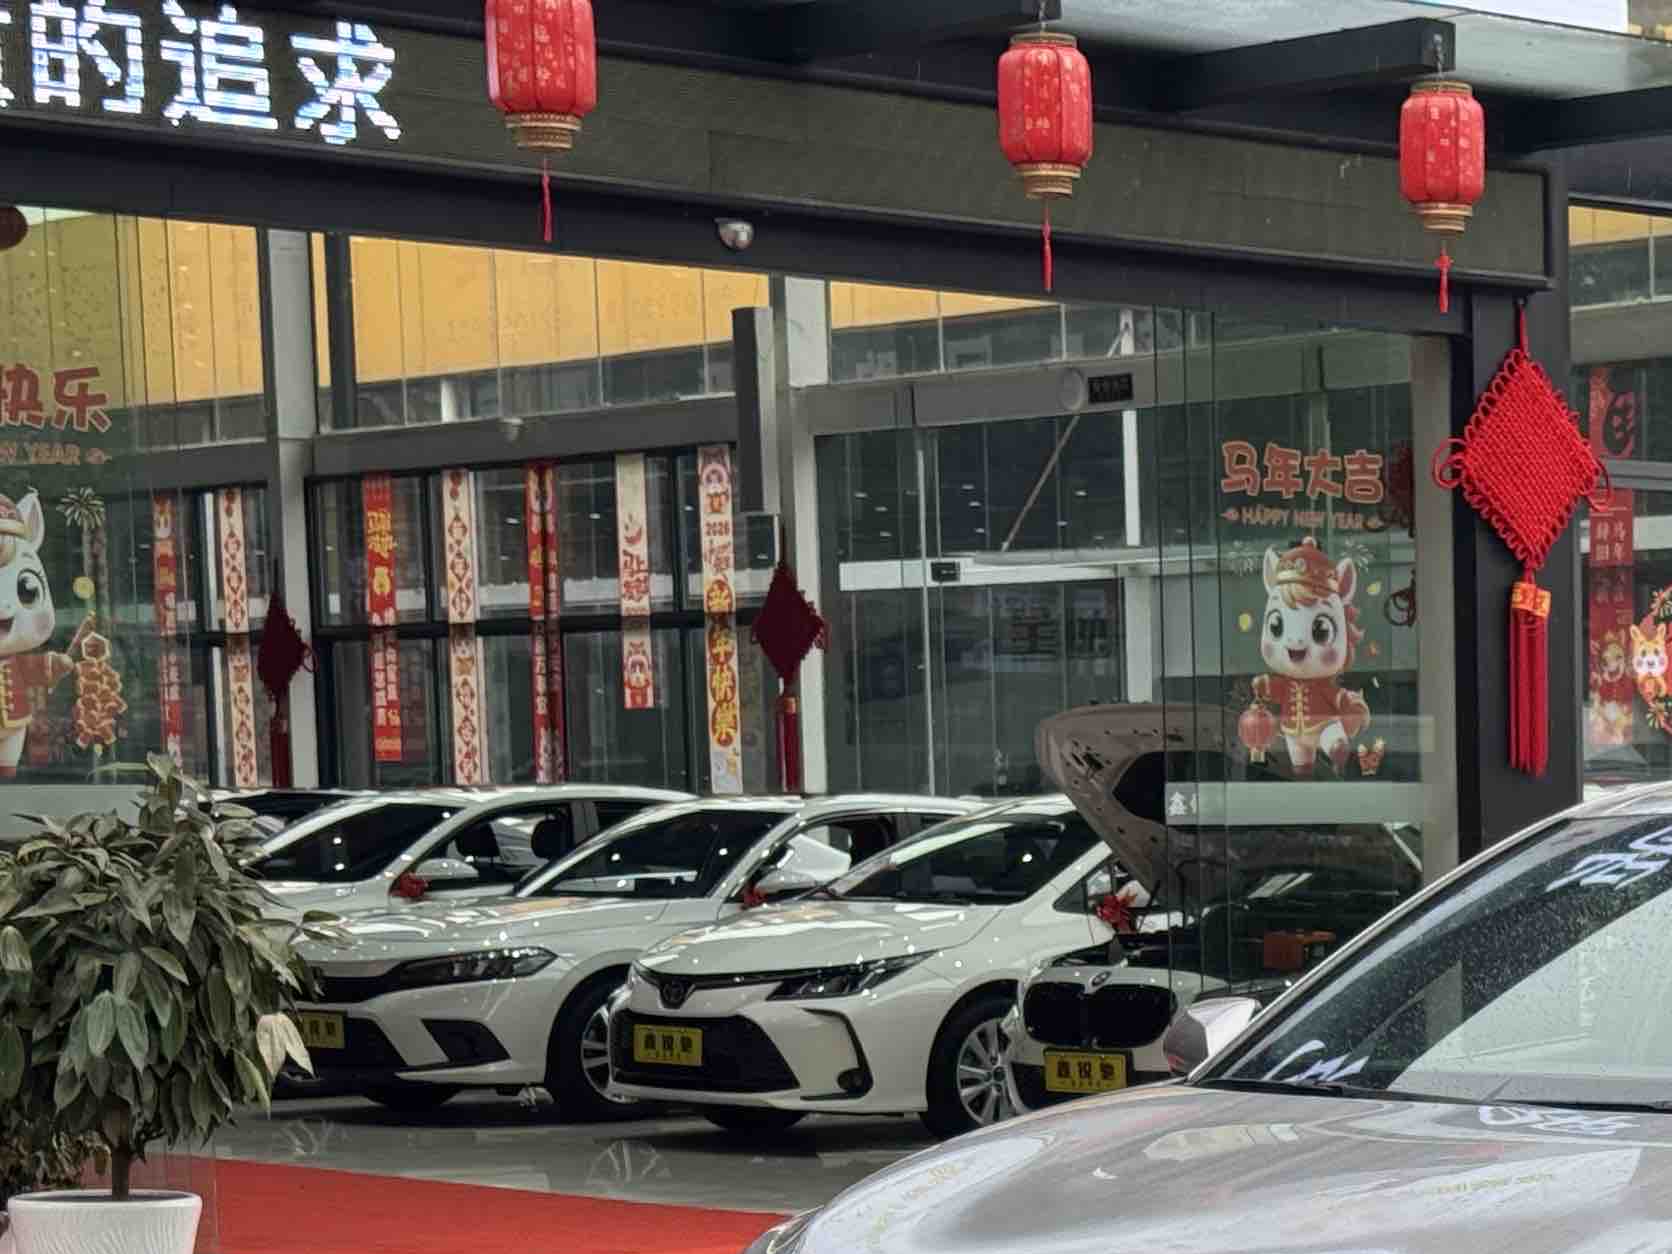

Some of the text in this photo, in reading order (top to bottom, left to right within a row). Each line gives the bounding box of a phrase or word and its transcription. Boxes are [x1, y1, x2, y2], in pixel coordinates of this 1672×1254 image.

[0, 0, 402, 145] 的追求
[1221, 440, 1385, 504] 马年大吉
[1242, 506, 1290, 526] HAPPY
